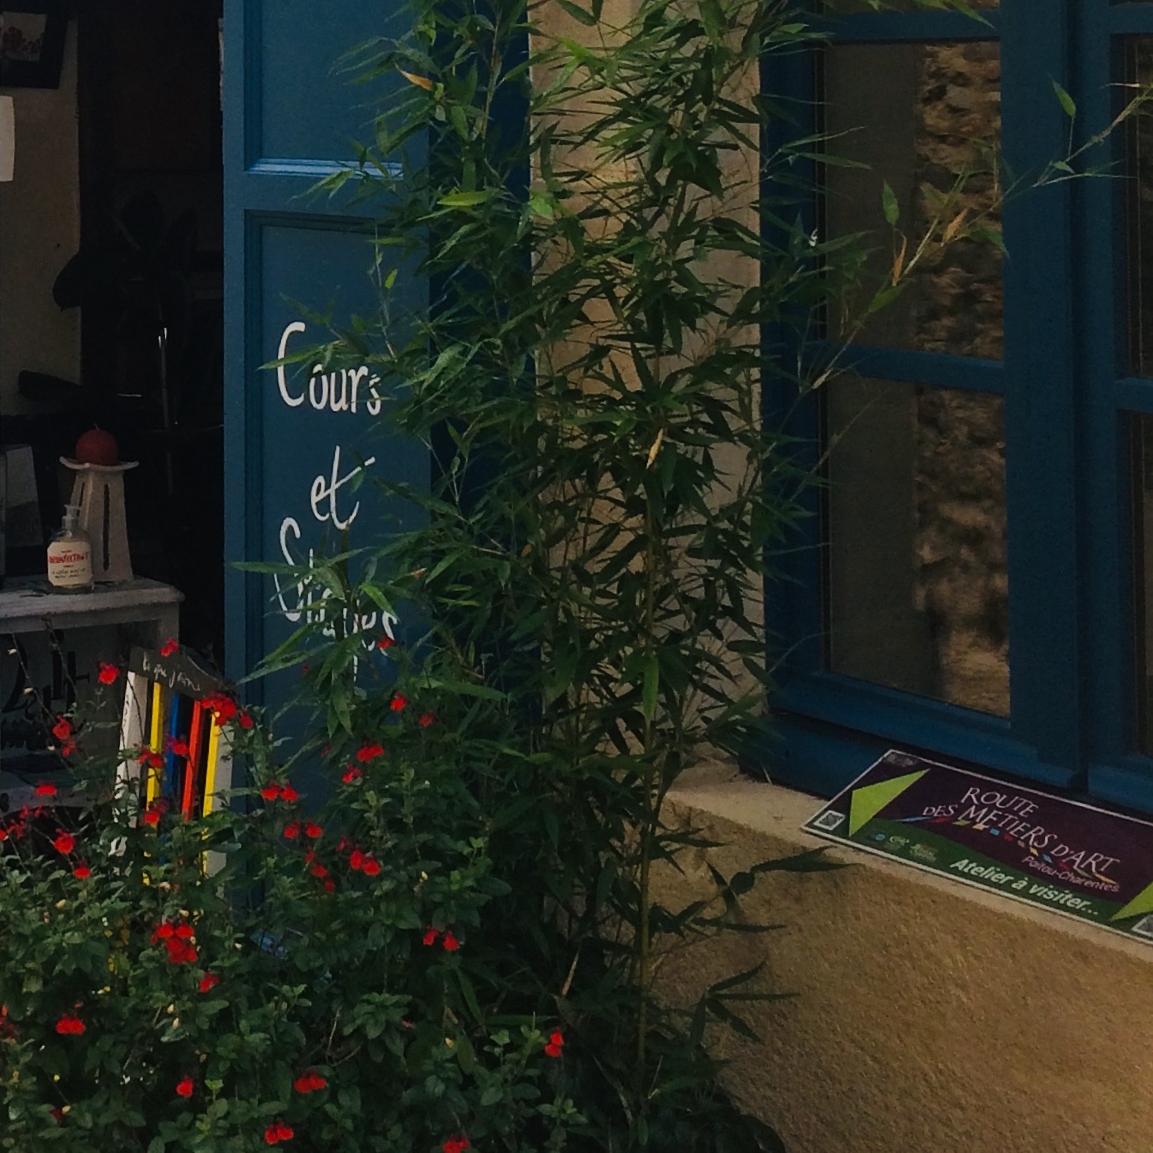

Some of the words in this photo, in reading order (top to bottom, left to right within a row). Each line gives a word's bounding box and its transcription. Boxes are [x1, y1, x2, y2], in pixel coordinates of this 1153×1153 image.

[277, 321, 382, 416] Cours
[310, 445, 375, 530] et
[960, 786, 1039, 818] ROUTE
[922, 804, 958, 817] DES
[1050, 842, 1121, 873] D'ART
[949, 858, 1015, 885] Atelier
[1011, 876, 1029, 891] à
